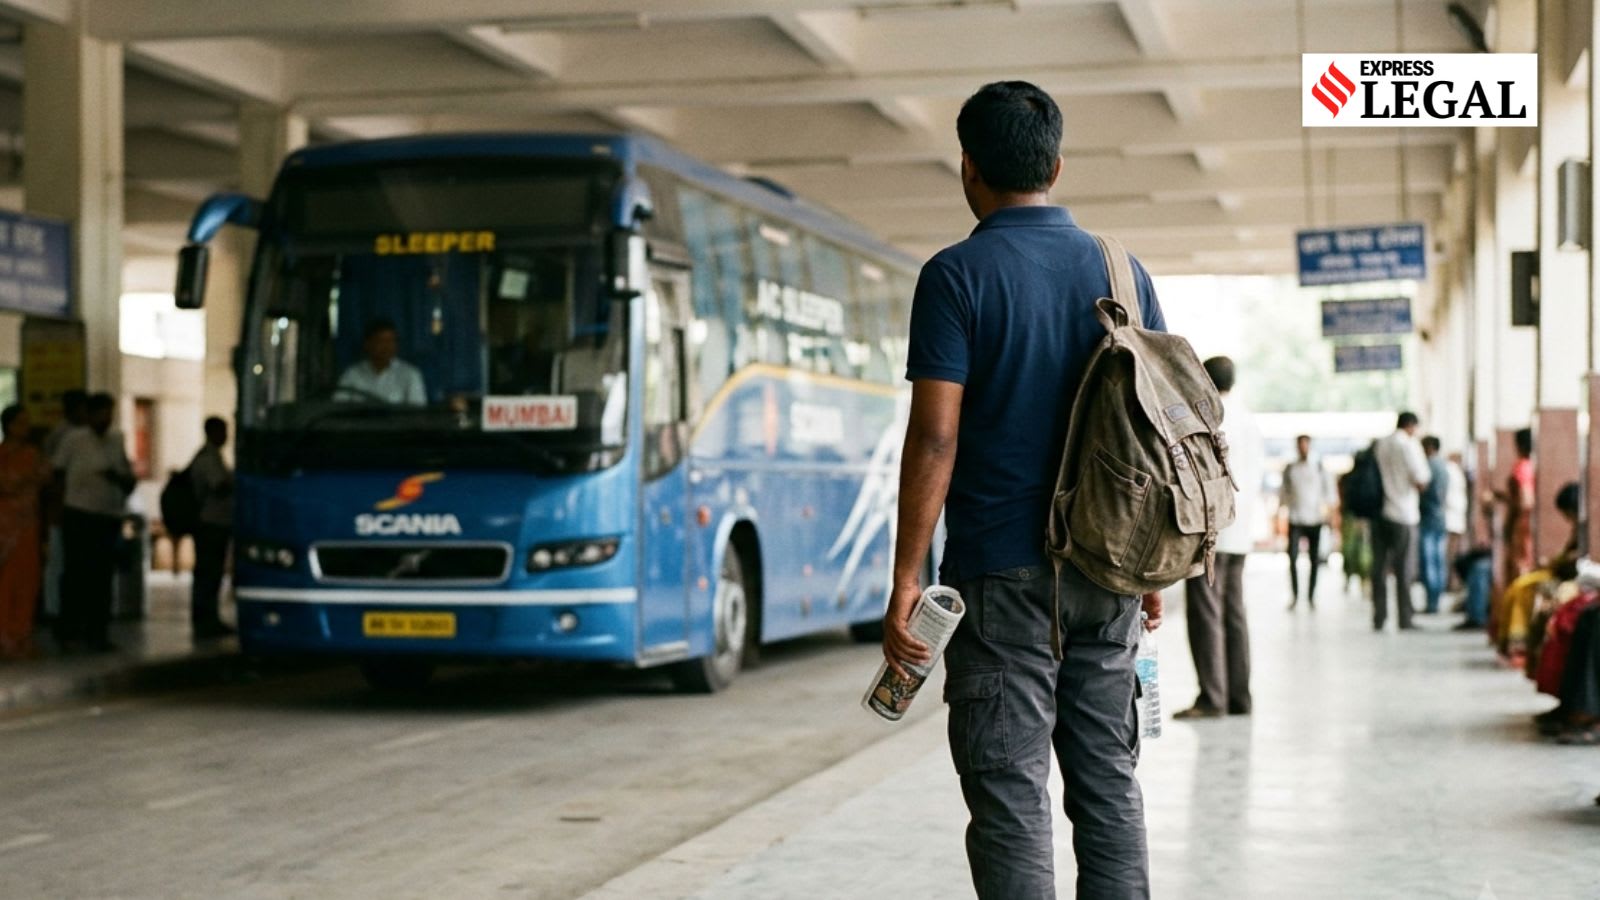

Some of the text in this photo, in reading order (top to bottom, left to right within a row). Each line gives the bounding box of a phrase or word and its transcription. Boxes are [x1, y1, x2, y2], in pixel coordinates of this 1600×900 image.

[375, 231, 496, 255] SLEEPER
[487, 402, 573, 427] MUMBAI
[355, 513, 462, 536] SCANIA
